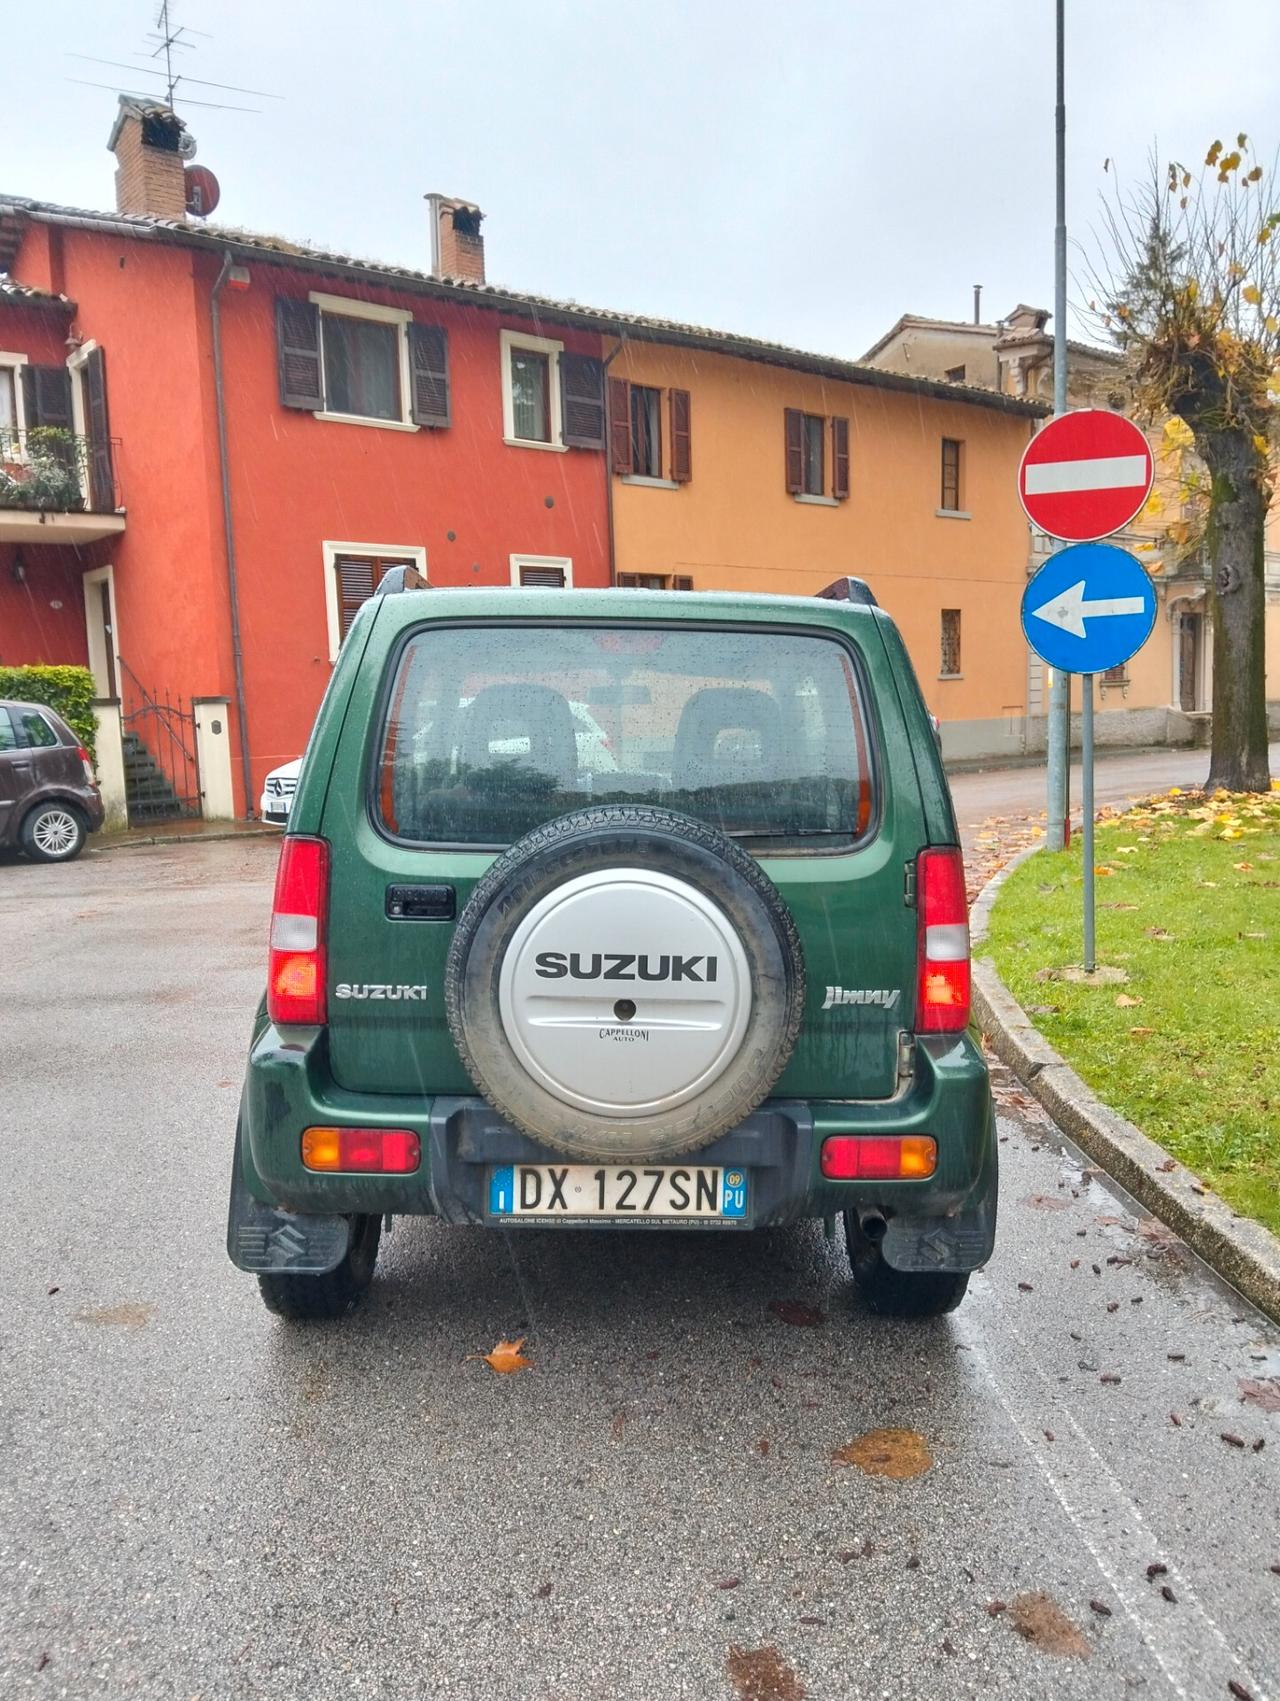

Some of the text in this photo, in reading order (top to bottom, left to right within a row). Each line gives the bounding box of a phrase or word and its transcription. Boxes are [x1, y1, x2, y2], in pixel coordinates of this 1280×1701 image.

[535, 952, 718, 982] SUZUKI
[335, 984, 428, 1000] SUZUKI
[821, 986, 901, 1009] Jimny
[599, 1027, 649, 1042] CAPPELLONI
[520, 1167, 719, 1211] DX 127SN
[729, 1174, 741, 1185] 09
[499, 1191, 505, 1209] I
[724, 1189, 744, 1209] PU
